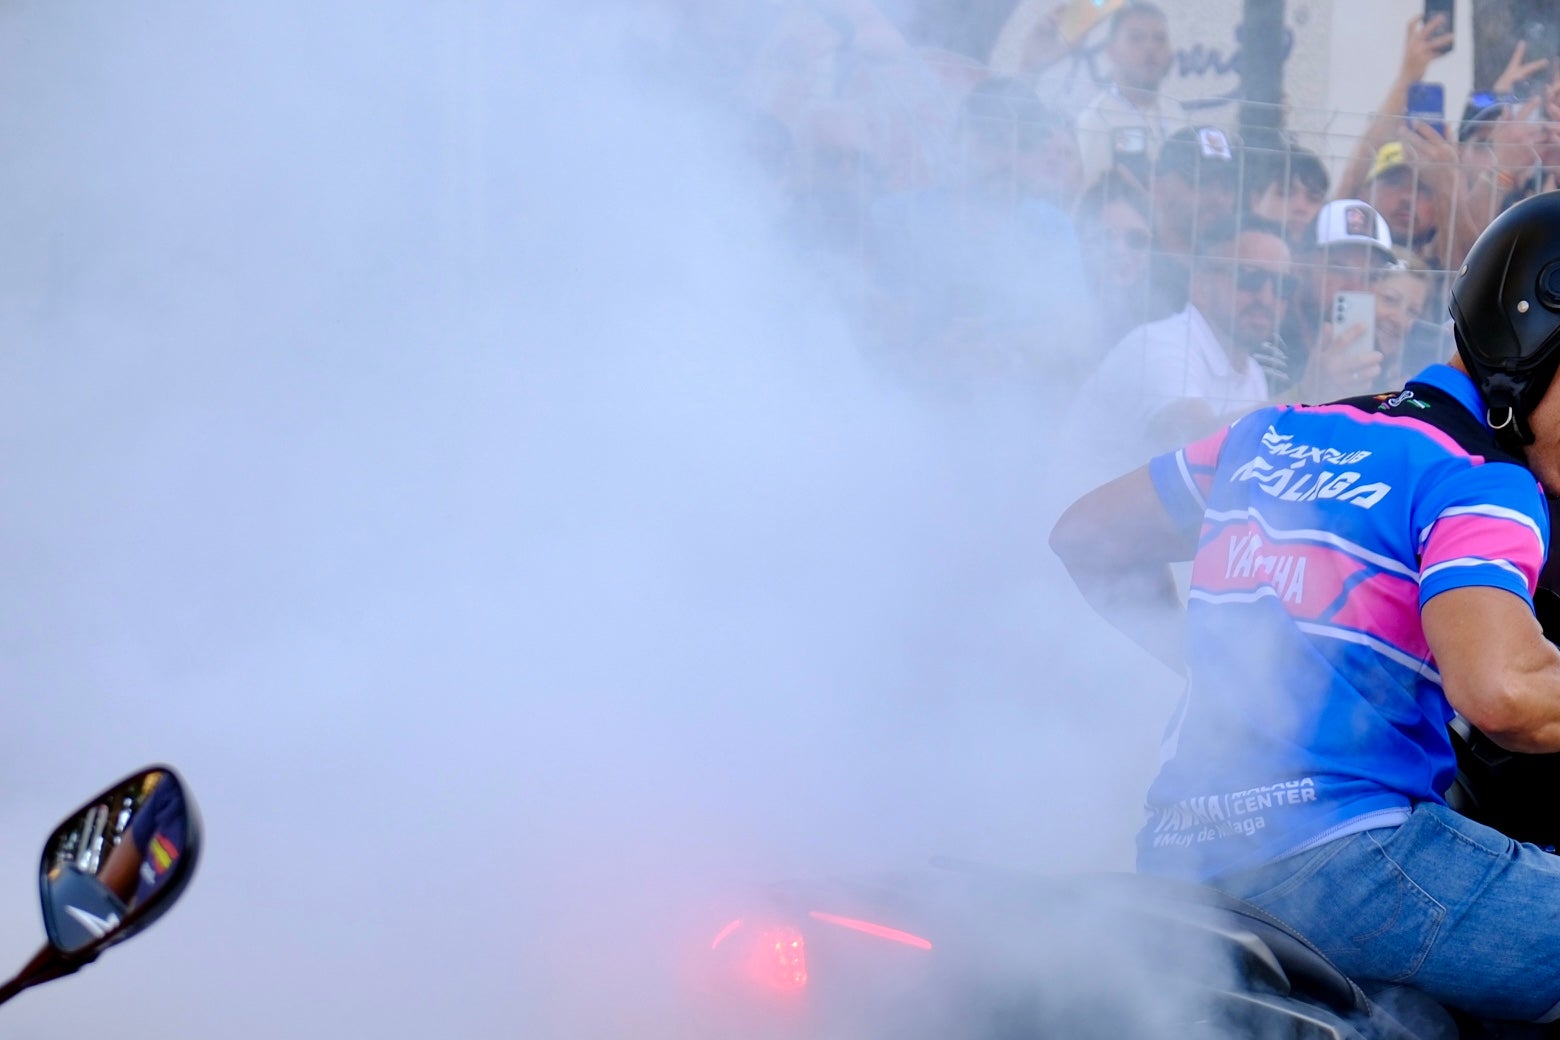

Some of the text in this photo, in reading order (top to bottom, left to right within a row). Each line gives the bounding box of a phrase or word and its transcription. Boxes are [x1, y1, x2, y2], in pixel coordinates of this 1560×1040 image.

[1225, 532, 1307, 604] YAHA
[1232, 787, 1317, 815] CENTER
[1197, 825, 1216, 843] de
